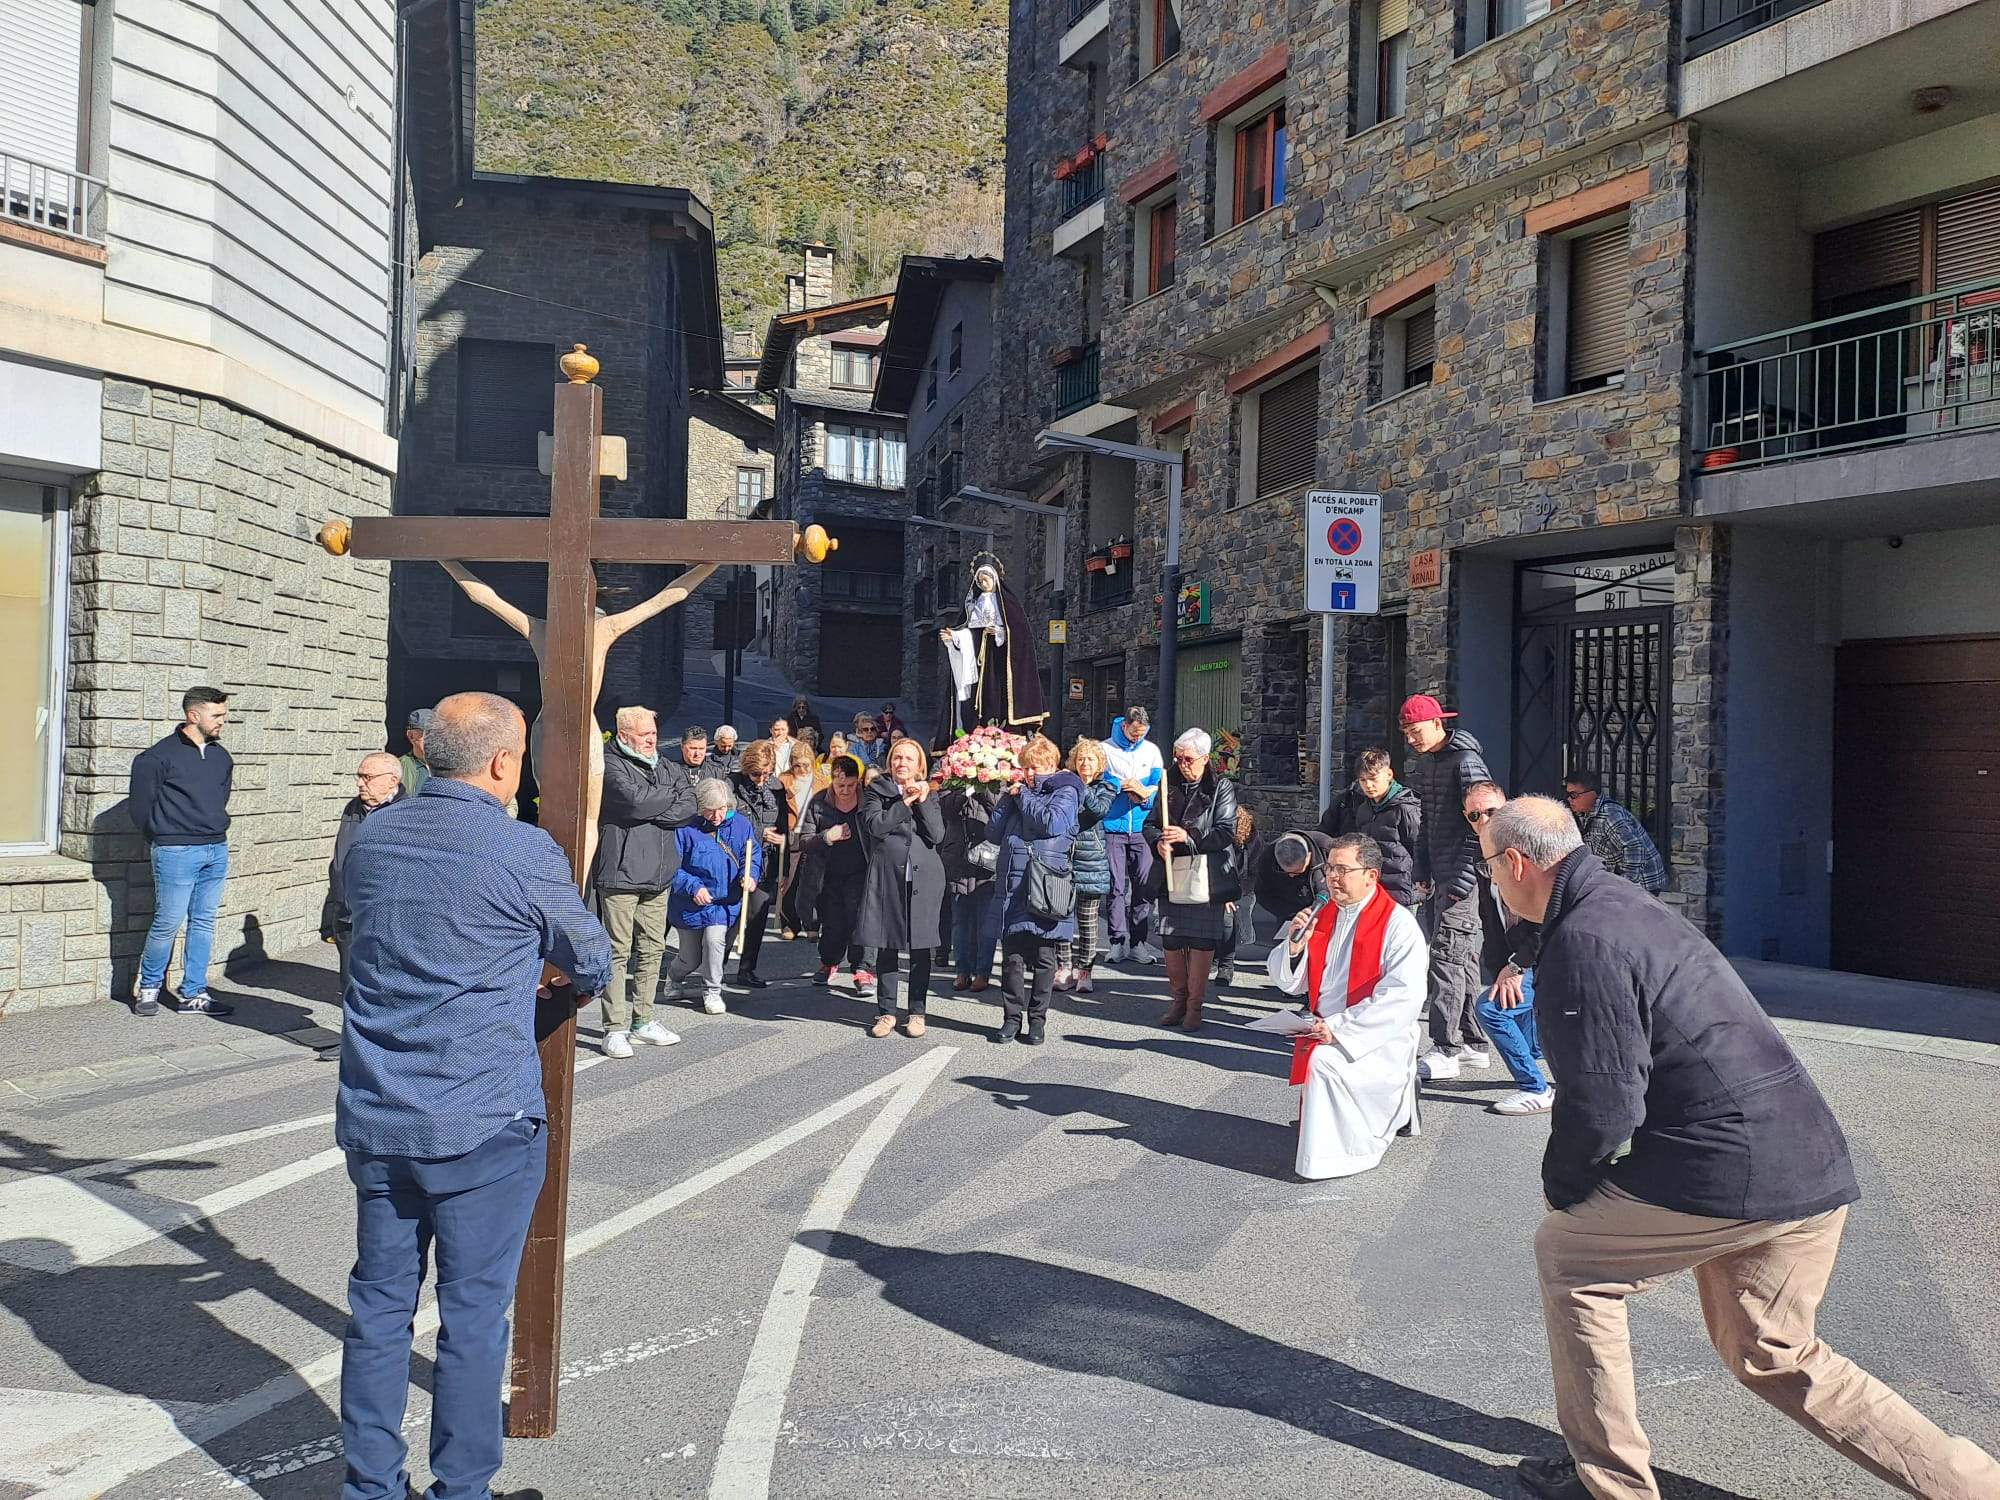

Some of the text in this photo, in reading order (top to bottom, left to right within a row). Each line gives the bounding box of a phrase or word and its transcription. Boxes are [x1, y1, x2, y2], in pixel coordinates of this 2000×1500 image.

[1312, 494, 1378, 506] ACCÉS AL POBLET
[1326, 506, 1364, 515] D'ENCAMP
[1326, 558, 1343, 566] TOTA
[1355, 559, 1373, 567] ZONA
[1414, 553, 1434, 567] CASA
[1574, 555, 1666, 580] CASA ARNAU
[1412, 570, 1435, 585] ARNAU
